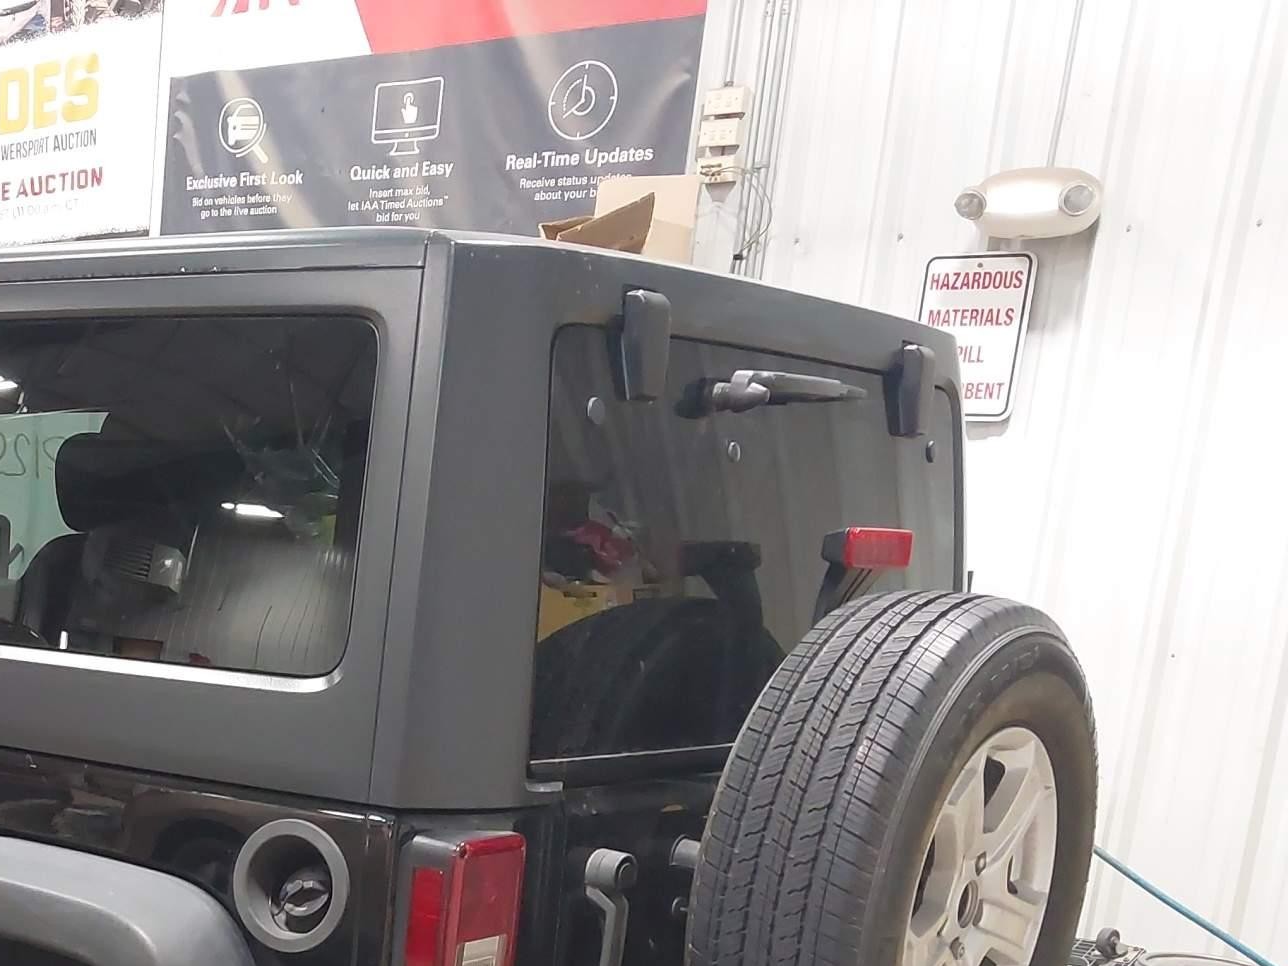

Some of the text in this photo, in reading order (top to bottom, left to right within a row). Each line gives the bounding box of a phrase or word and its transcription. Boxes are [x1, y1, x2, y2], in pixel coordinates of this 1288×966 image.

[53, 128, 97, 152] AUCTION
[505, 147, 654, 170] Real-Time Updates
[350, 161, 454, 180] Quick and Easy
[16, 167, 103, 199] AUCTION
[186, 169, 303, 190] Exclusive First Look
[519, 176, 555, 189] Receive
[557, 174, 588, 187] status
[192, 191, 293, 207] Bid on vehicles before they
[369, 184, 431, 199] Insert max bid,
[534, 190, 561, 200] about
[564, 188, 587, 201] your
[200, 205, 277, 220] go to the live auction
[348, 201, 360, 211] let
[380, 199, 405, 209] Timed
[375, 212, 420, 223] bid for you
[929, 270, 1024, 291] HAZARDOUS
[928, 308, 1015, 327] MATERIALS
